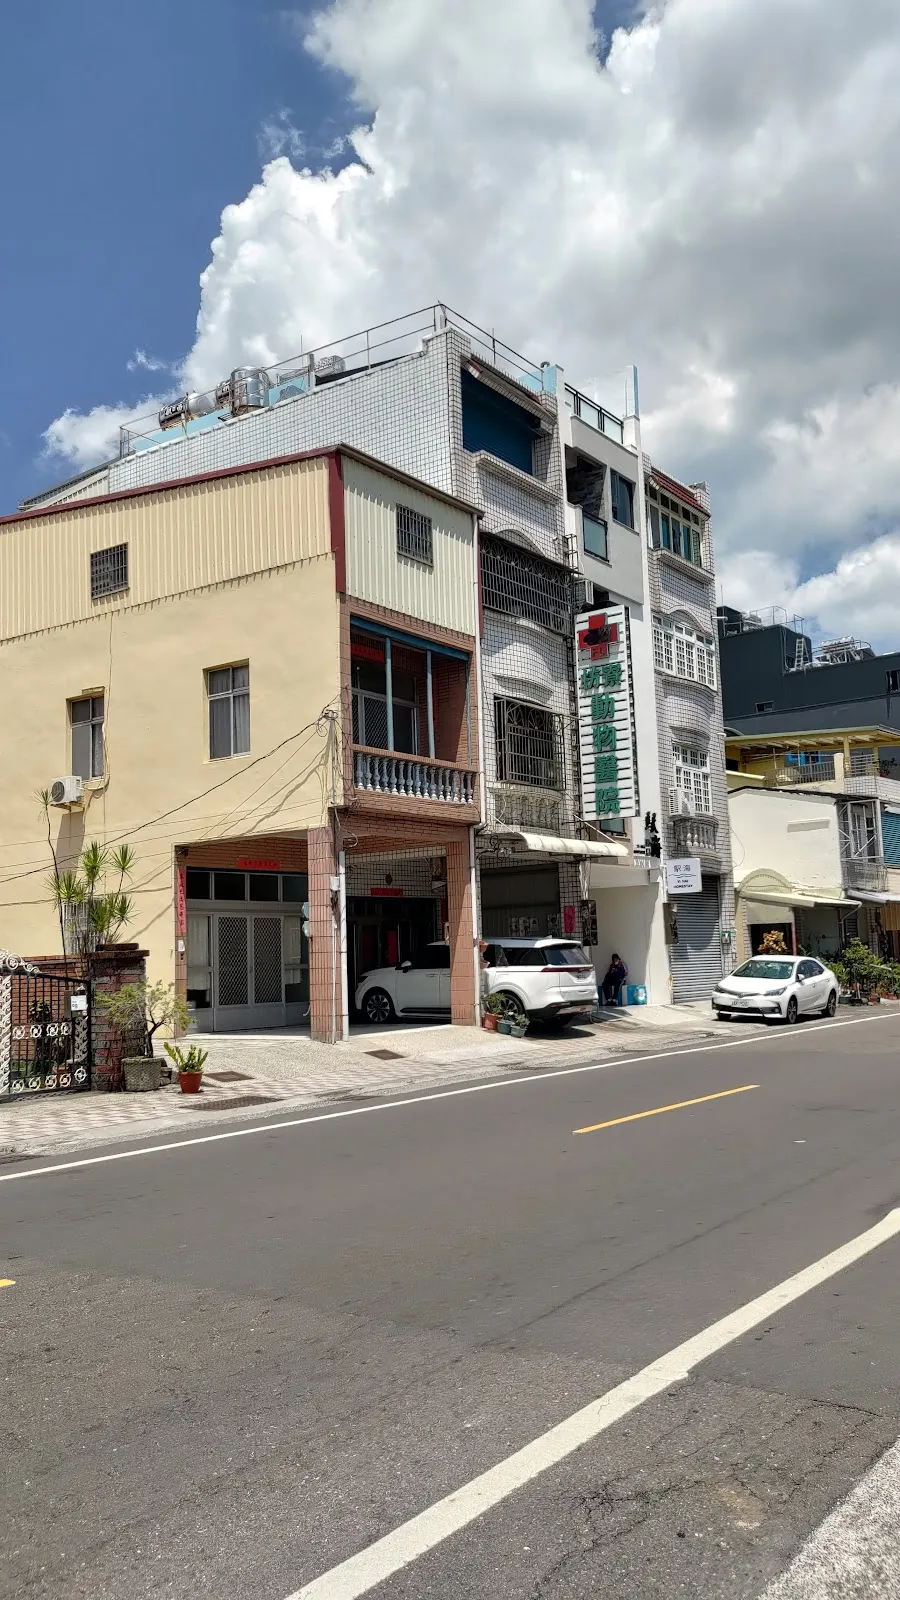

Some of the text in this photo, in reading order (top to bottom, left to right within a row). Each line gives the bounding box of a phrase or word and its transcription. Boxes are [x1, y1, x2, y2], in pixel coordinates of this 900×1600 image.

[581, 663, 621, 690] 枋寮
[591, 693, 621, 815] 動物醫院
